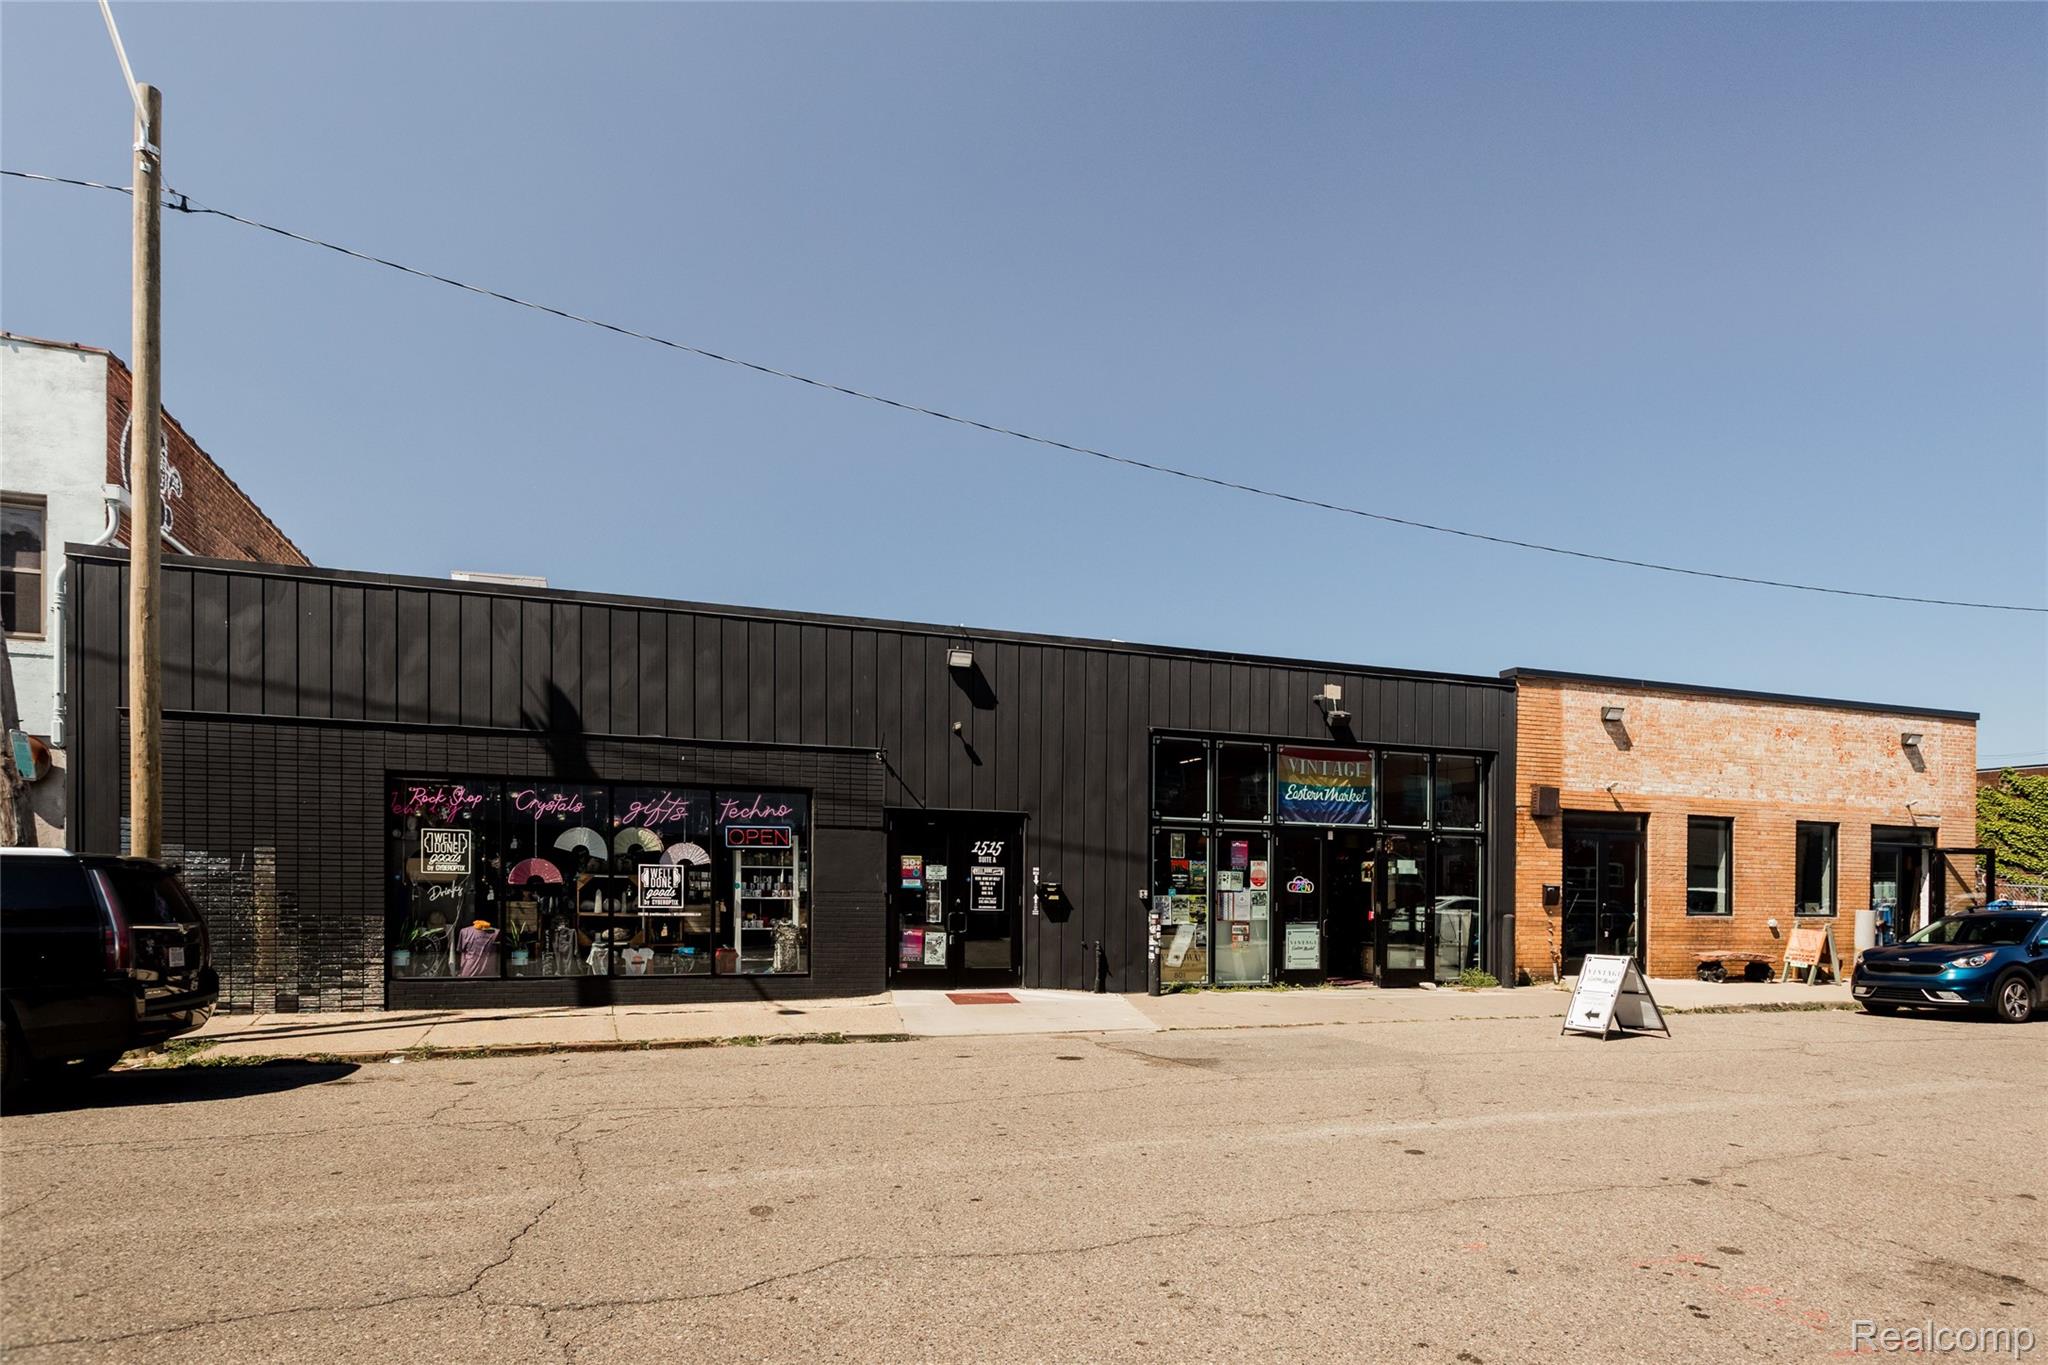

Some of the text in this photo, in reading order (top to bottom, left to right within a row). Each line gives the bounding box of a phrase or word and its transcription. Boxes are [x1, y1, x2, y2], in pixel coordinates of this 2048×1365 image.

[1288, 758, 1367, 778] VINTAGE
[408, 786, 448, 806] Rock
[449, 785, 483, 809] Shop
[1285, 784, 1369, 803] Eastern Market
[515, 789, 586, 821] Crystals
[622, 791, 690, 828] gifts
[433, 833, 459, 844] WELL
[728, 829, 789, 847] OPEN
[433, 842, 459, 854] DONE
[971, 841, 1005, 857] 1515
[428, 853, 462, 865] goods
[978, 856, 997, 864] SUITE A
[650, 868, 671, 878] WELL
[650, 878, 672, 888] DONE
[645, 887, 676, 900] goods
